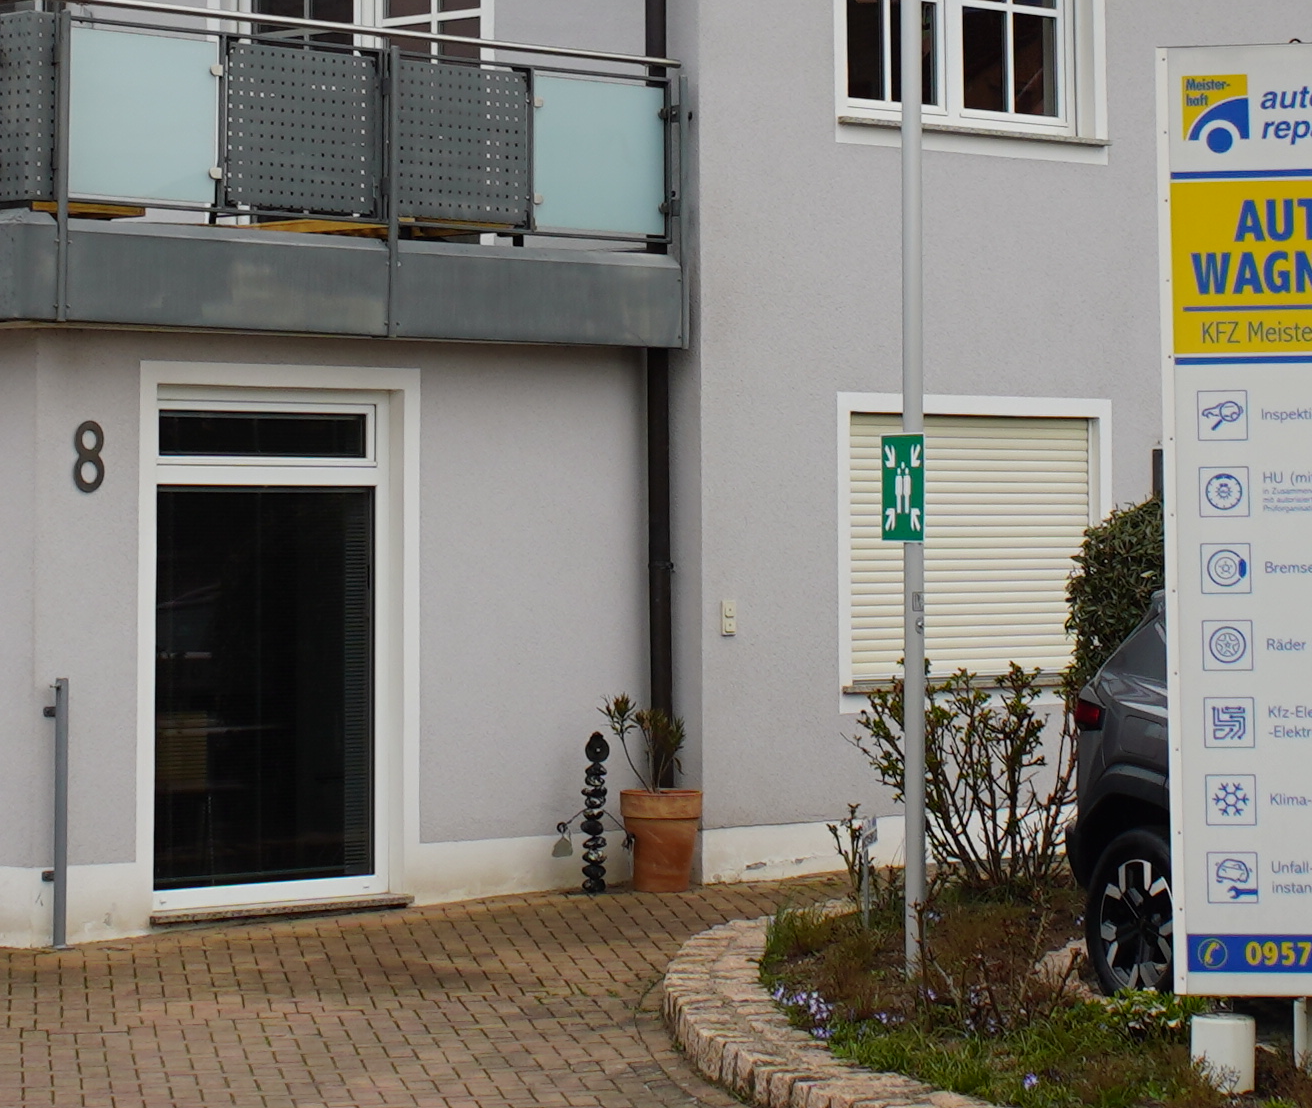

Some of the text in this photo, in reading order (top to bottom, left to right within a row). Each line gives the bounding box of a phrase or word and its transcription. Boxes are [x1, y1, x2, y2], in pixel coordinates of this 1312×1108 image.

[1185, 78, 1231, 92] Meister-
[1186, 93, 1209, 107] haft
[1201, 321, 1240, 344] KFZ
[73, 420, 105, 493] 8
[1263, 471, 1283, 484] HU
[1266, 637, 1306, 651] Räder
